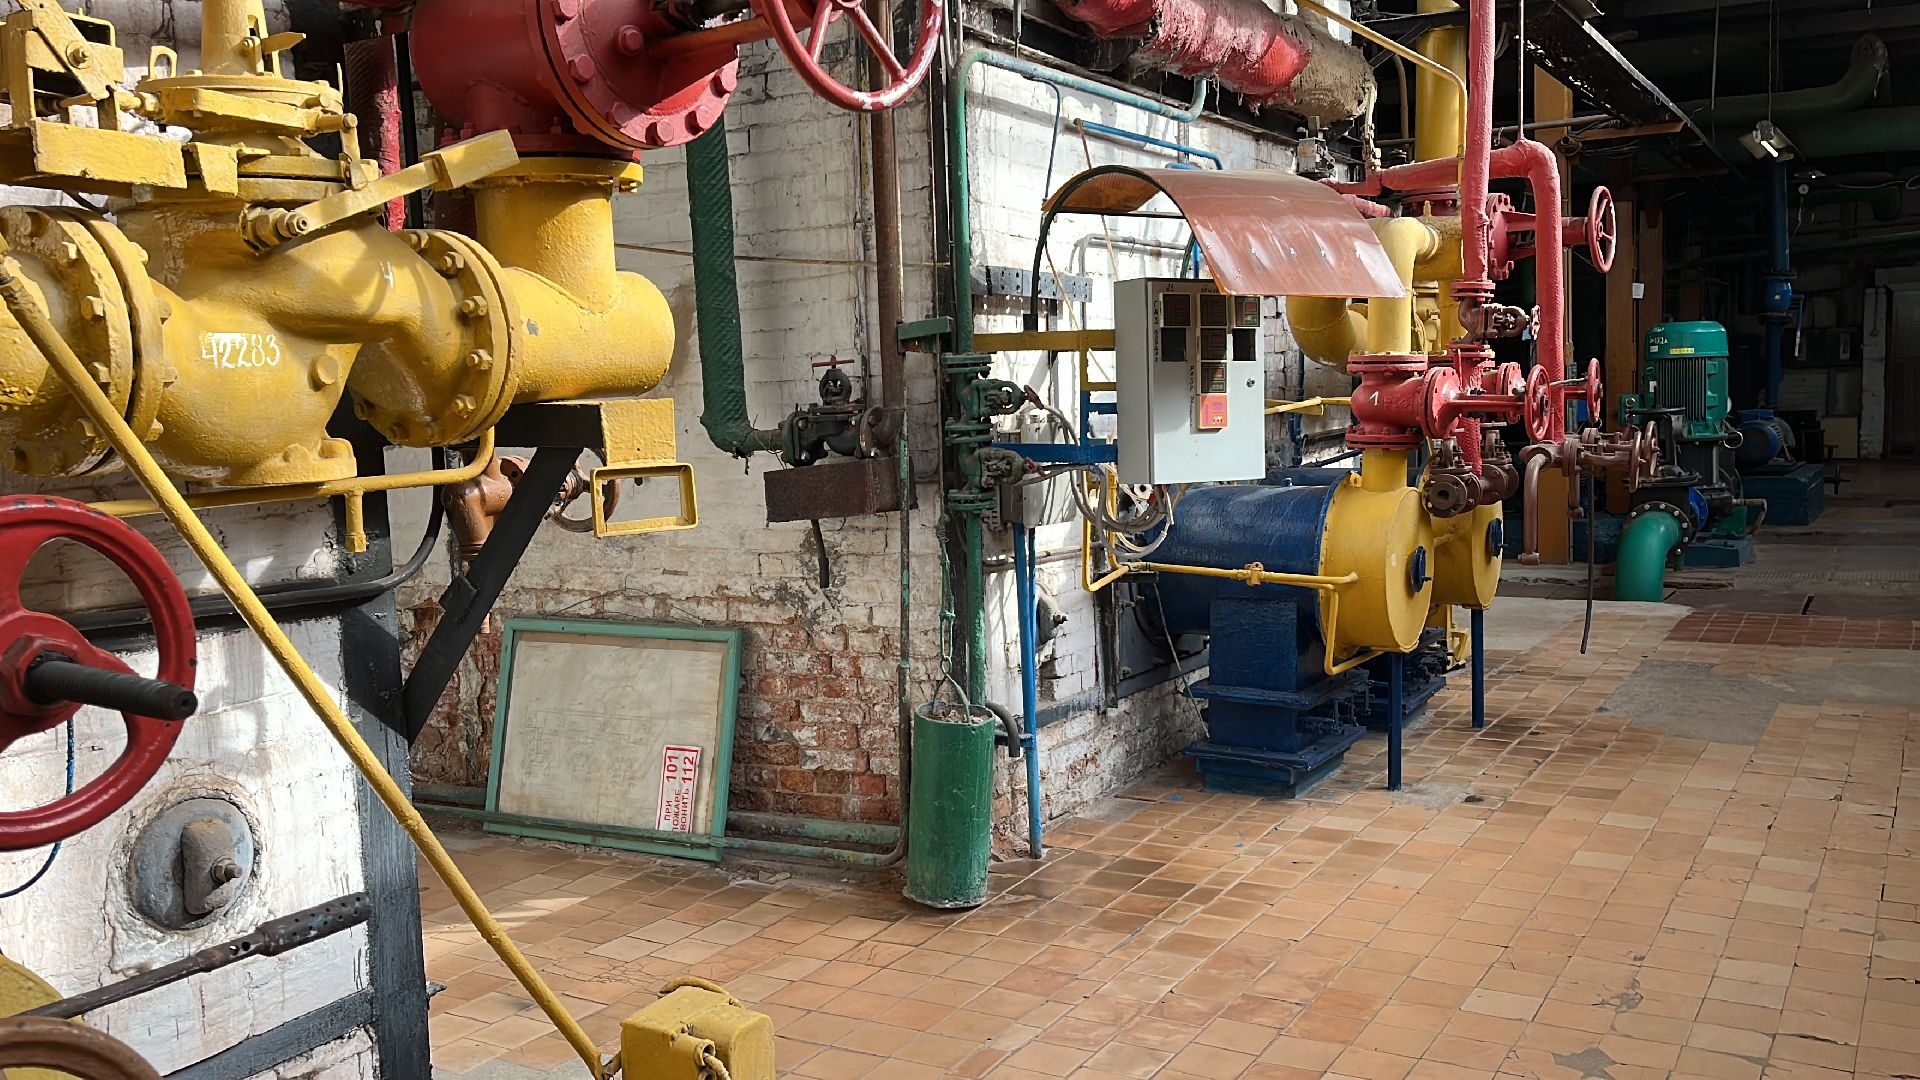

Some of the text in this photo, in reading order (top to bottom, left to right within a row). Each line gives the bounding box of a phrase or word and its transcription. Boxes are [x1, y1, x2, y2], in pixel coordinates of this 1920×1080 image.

[379, 260, 394, 290] 4
[200, 332, 281, 369] 42283
[1367, 390, 1380, 406] 1
[665, 755, 679, 783] 101
[681, 756, 695, 784] 112
[664, 800, 673, 821] ПРИ
[680, 788, 690, 833] ВОНИТЬ
